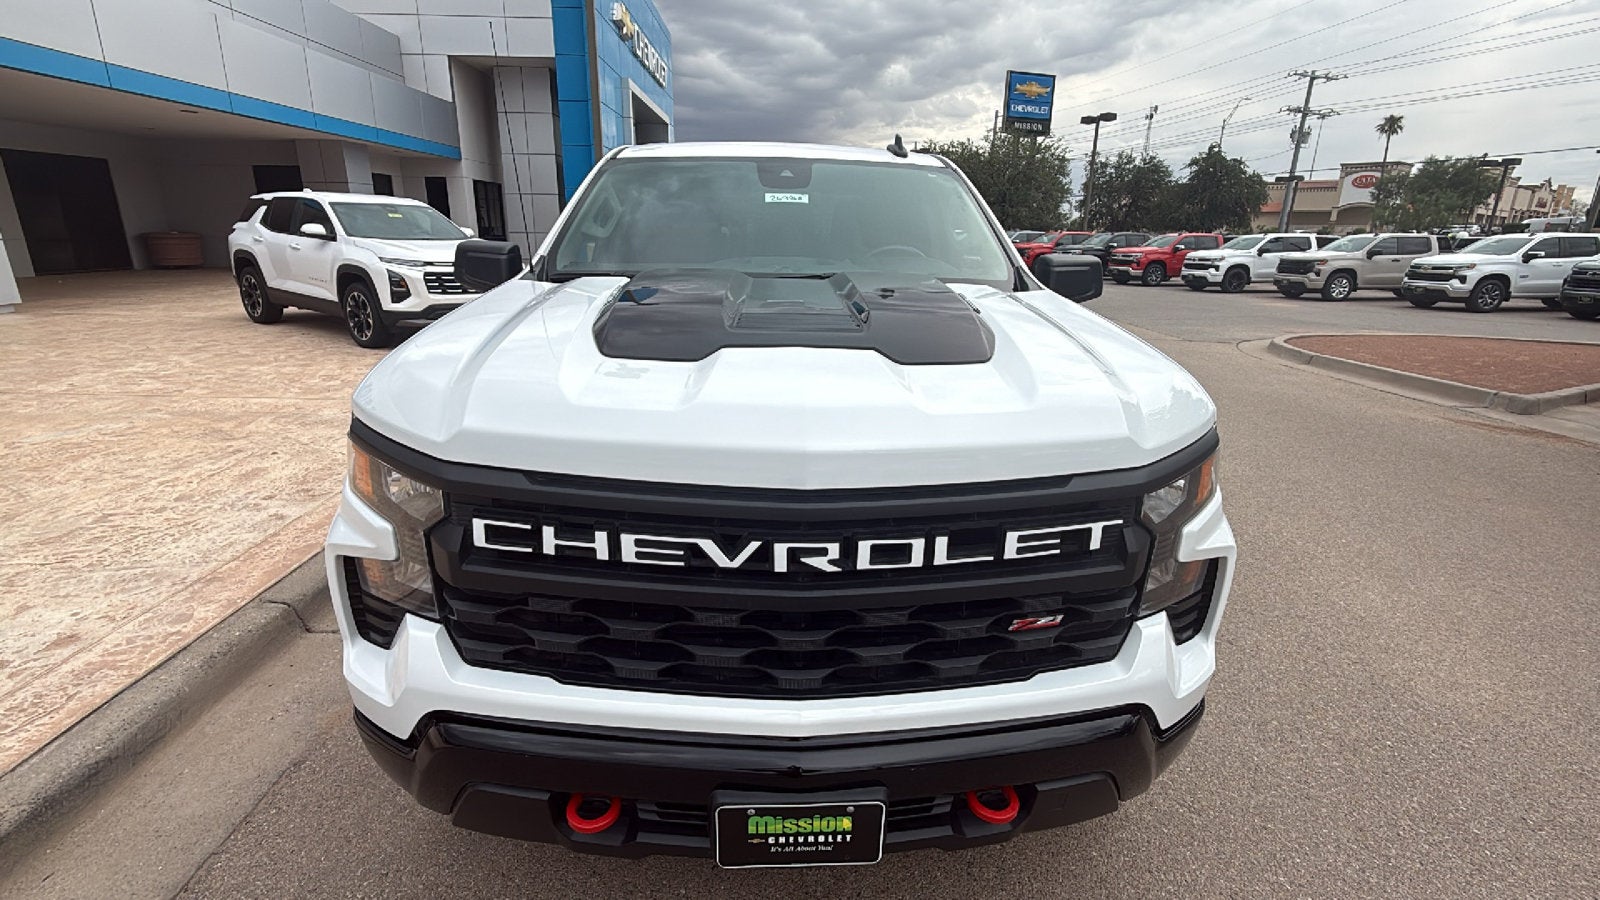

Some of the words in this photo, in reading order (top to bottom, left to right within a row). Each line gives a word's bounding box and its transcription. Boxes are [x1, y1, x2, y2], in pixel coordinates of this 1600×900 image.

[634, 23, 667, 88] CHEVROLET
[1011, 104, 1049, 114] CHEVROLET
[1014, 122, 1042, 131] MISSION
[472, 518, 1124, 573] CHEVROLET
[1008, 614, 1065, 632] Z71
[748, 814, 852, 834] Mission
[768, 835, 852, 844] CHEVROLET
